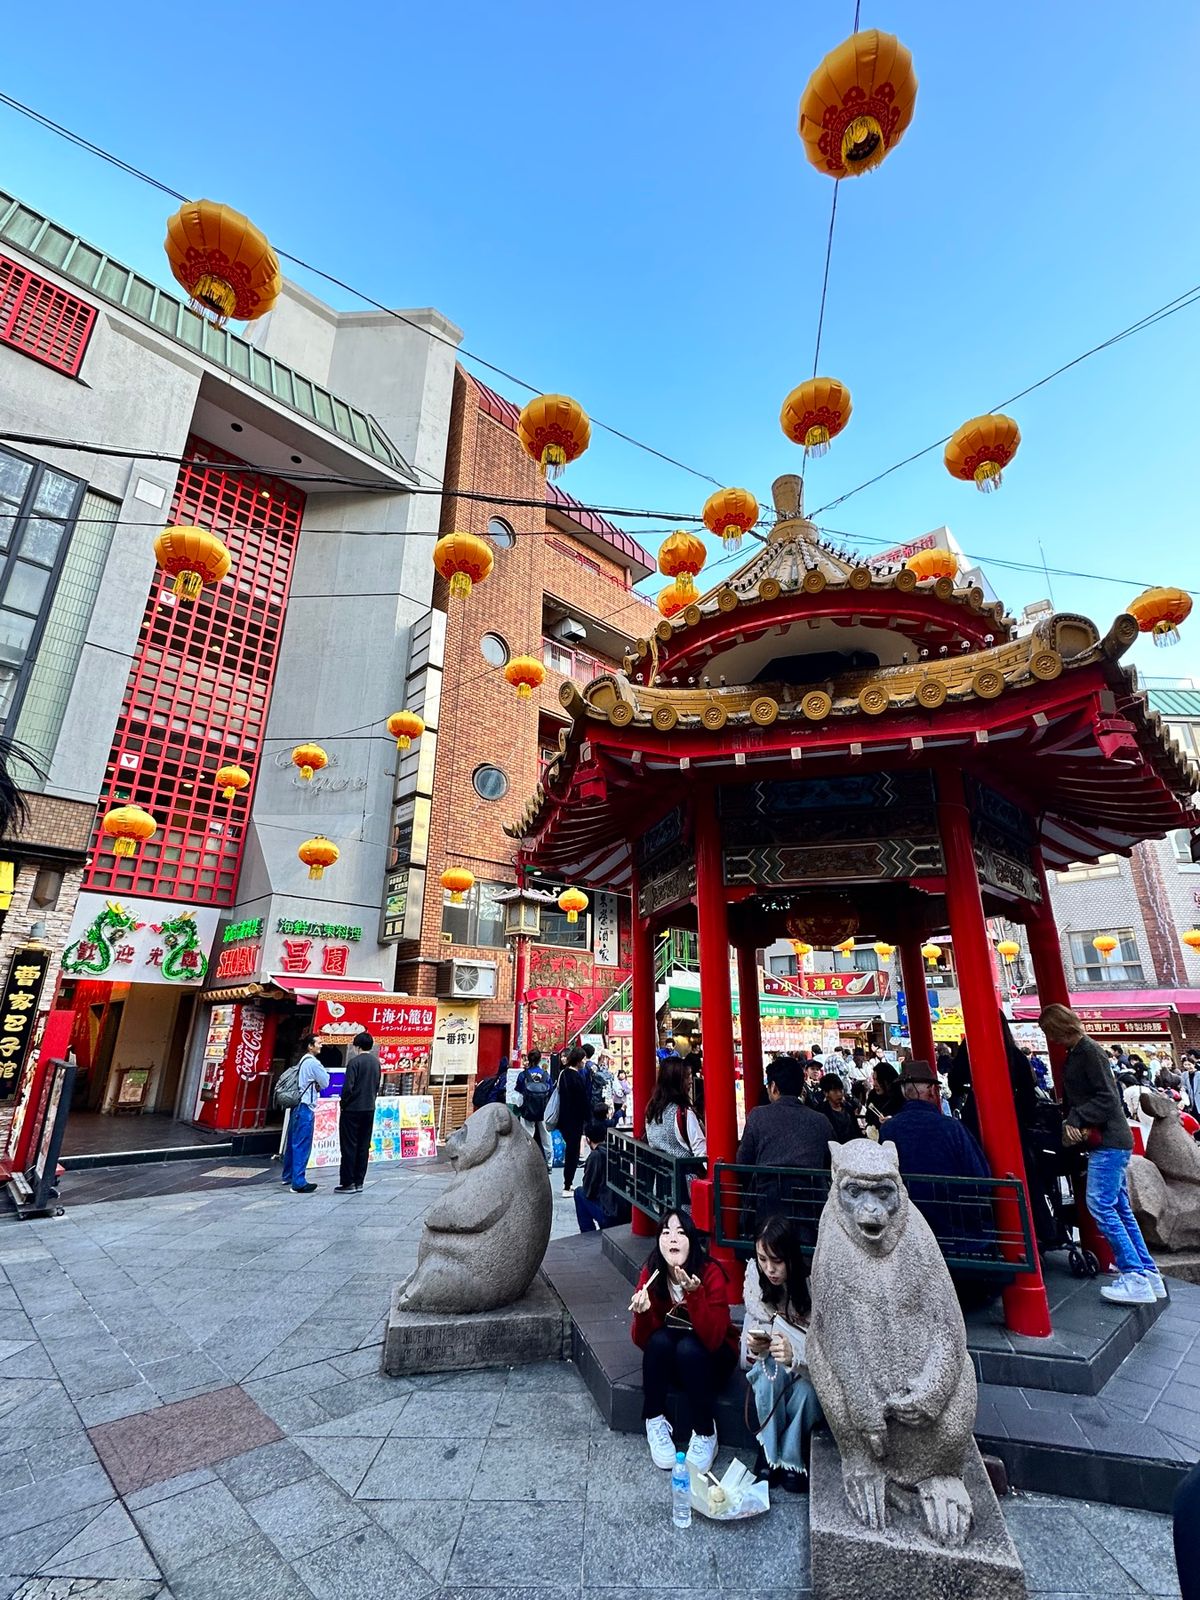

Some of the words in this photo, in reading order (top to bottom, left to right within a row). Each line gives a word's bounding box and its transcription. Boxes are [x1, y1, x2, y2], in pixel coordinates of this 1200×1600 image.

[276, 918, 362, 942] 海鮮広東料理
[281, 939, 351, 977] 昌園
[0, 964, 42, 1079] 曹家包子館
[367, 1007, 434, 1025] 上海小籠包
[436, 1033, 475, 1045] 一番搾り
